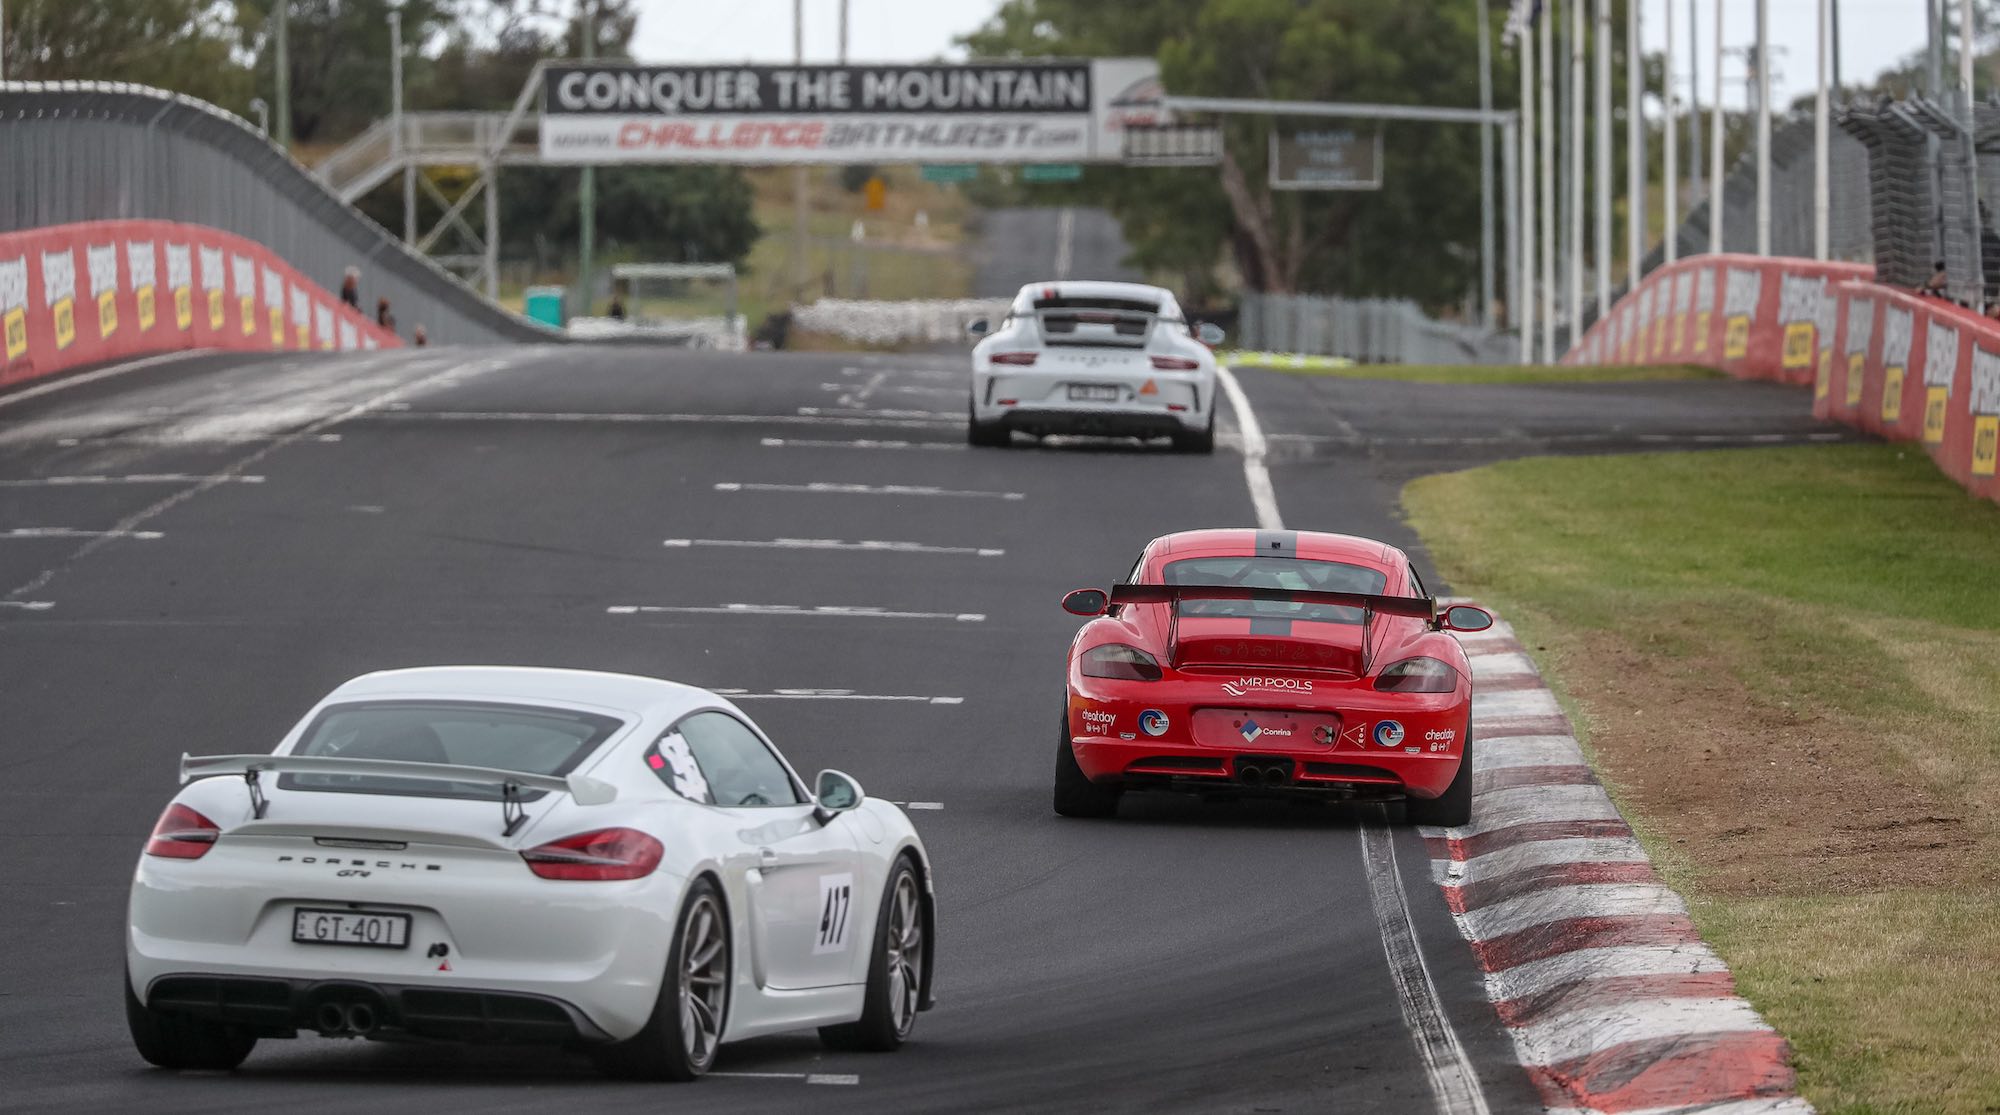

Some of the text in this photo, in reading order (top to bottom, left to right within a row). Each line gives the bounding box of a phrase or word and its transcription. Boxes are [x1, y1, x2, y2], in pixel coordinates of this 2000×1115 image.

[558, 70, 1086, 114] CONQUER THE MOUNTAIN
[1240, 677, 1261, 687] MR
[1265, 678, 1313, 691] POOLS
[1262, 727, 1292, 737] Conrina
[1357, 727, 1366, 744] TOW
[278, 855, 442, 871] PORSCHE
[336, 869, 372, 878] GT4
[820, 885, 850, 946] 417
